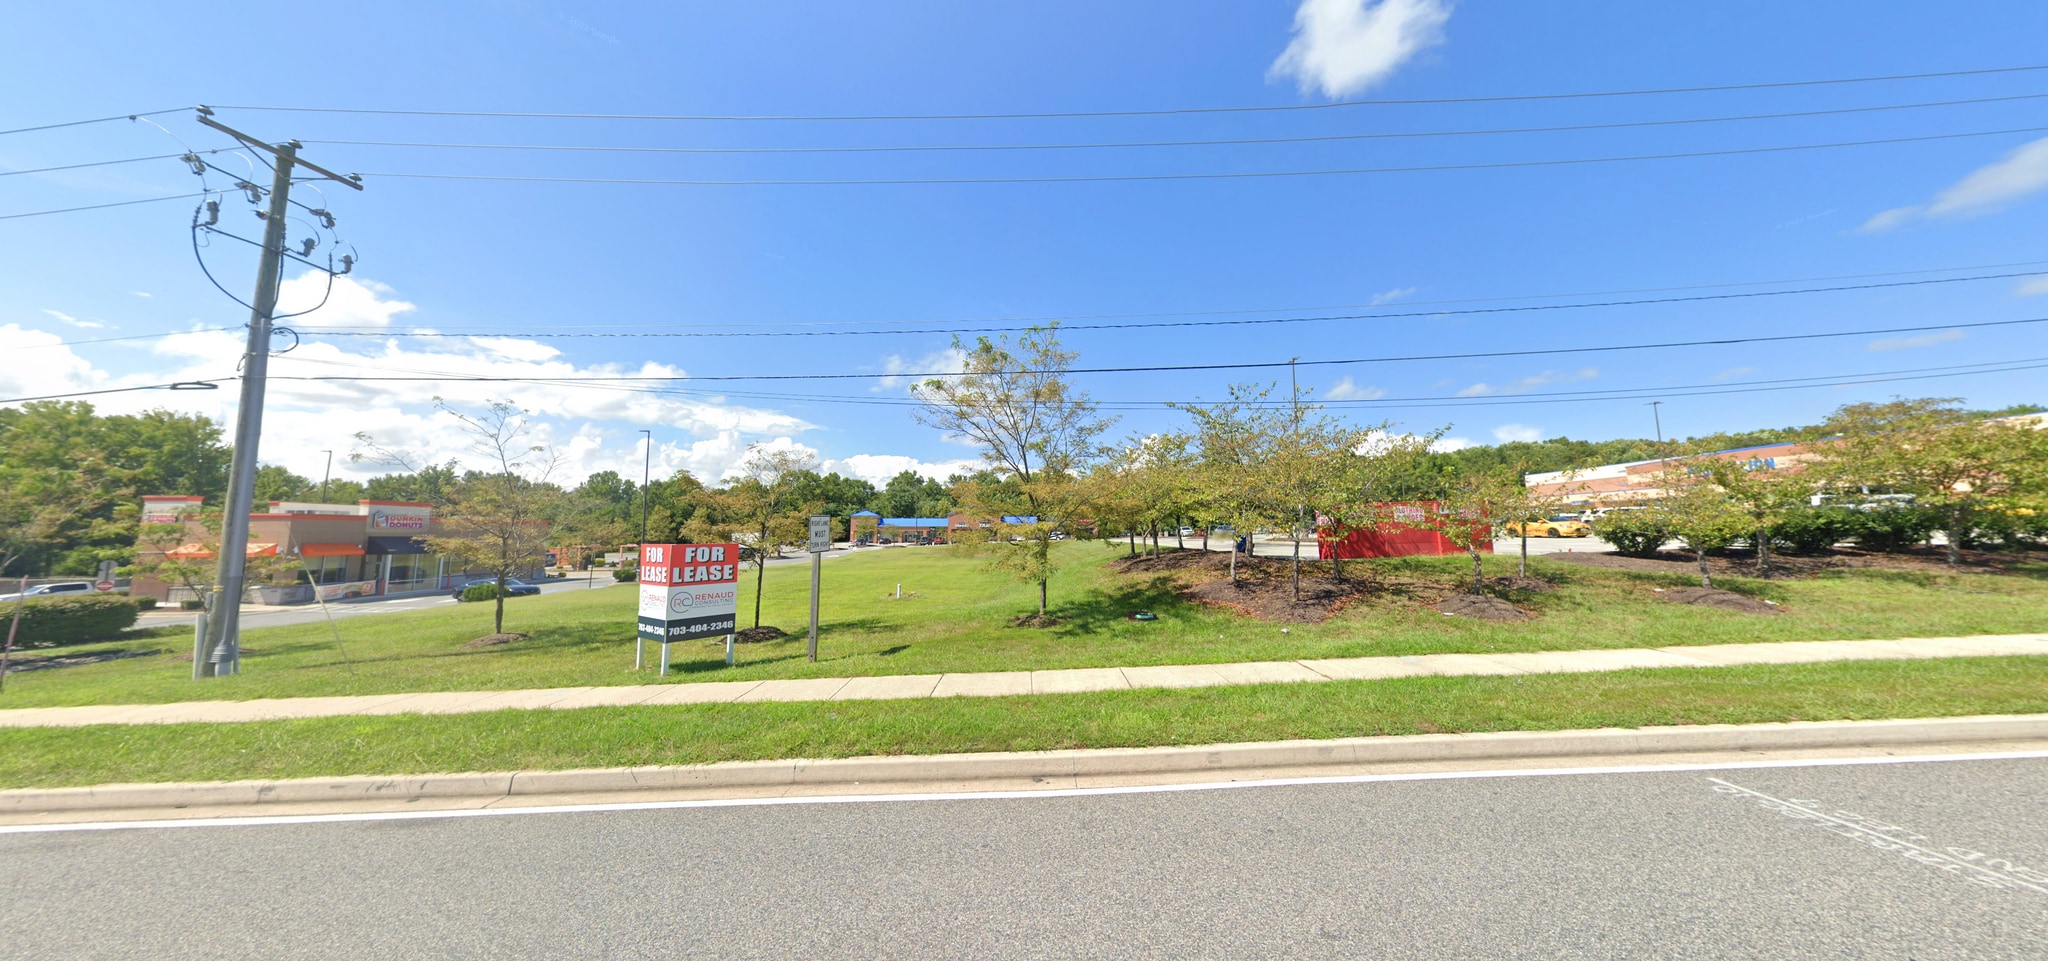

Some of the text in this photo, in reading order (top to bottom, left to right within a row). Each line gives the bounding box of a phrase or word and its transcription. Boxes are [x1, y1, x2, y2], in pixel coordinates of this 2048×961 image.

[814, 530, 826, 538] MUST
[646, 546, 664, 563] FOR
[684, 546, 726, 563] FOR
[641, 566, 667, 583] LEASE
[672, 564, 735, 583] LEASE
[695, 591, 734, 600] RENAUD
[695, 598, 734, 606] CONSULTING
[638, 622, 665, 636] 703-404-2346
[668, 620, 733, 636] 703-404-2346
